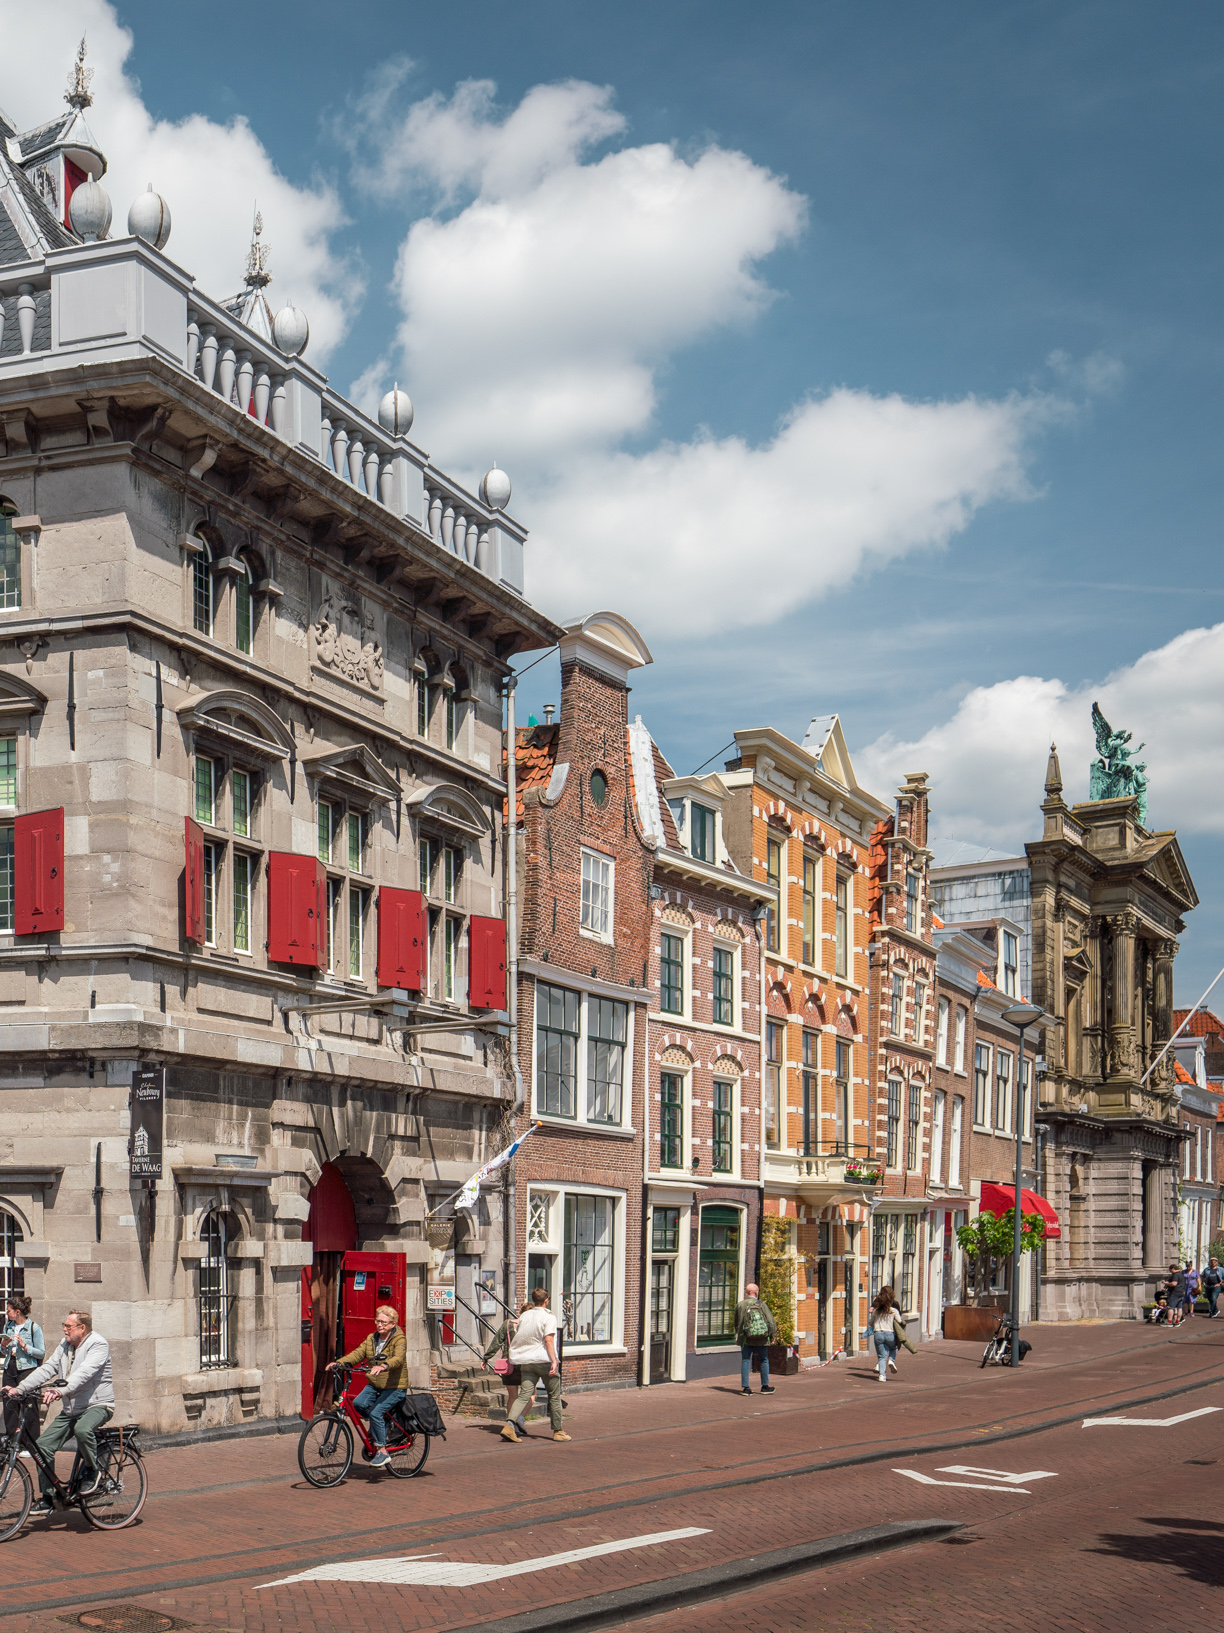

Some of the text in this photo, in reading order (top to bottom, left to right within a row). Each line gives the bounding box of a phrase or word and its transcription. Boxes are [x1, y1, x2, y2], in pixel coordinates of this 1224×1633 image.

[132, 1163, 161, 1172] DE WAAG
[428, 1297, 453, 1306] SITIES
